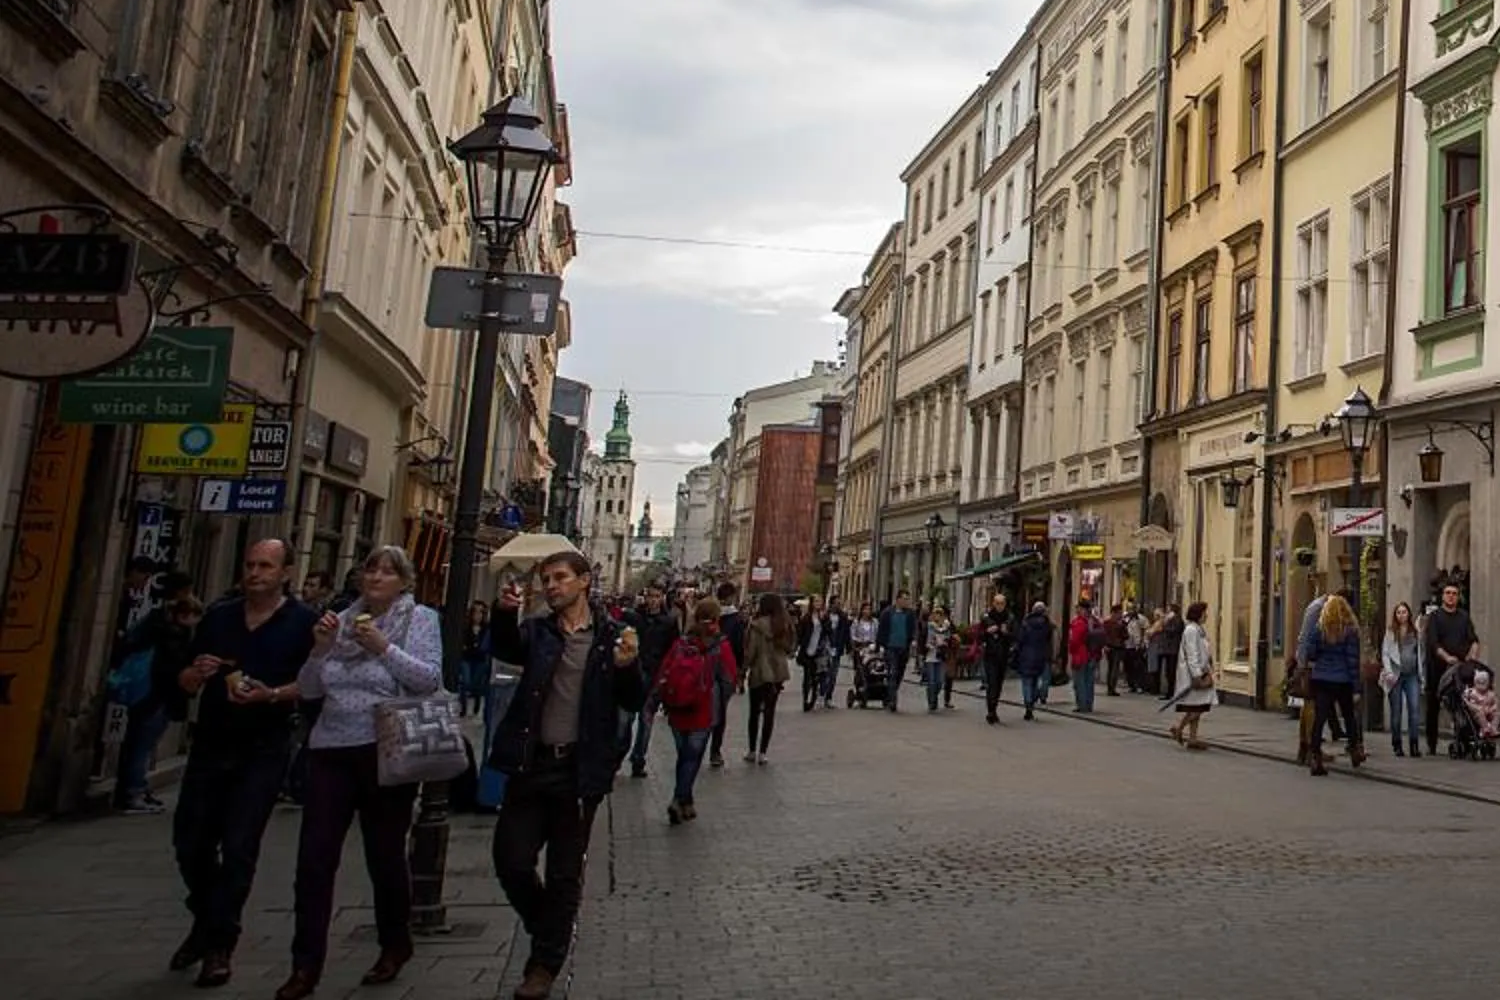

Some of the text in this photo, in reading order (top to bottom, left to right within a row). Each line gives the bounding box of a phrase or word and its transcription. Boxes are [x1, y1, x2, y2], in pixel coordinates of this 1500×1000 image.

[92, 396, 192, 416] wine bar
[238, 482, 278, 496] Local
[236, 497, 275, 510] tours
